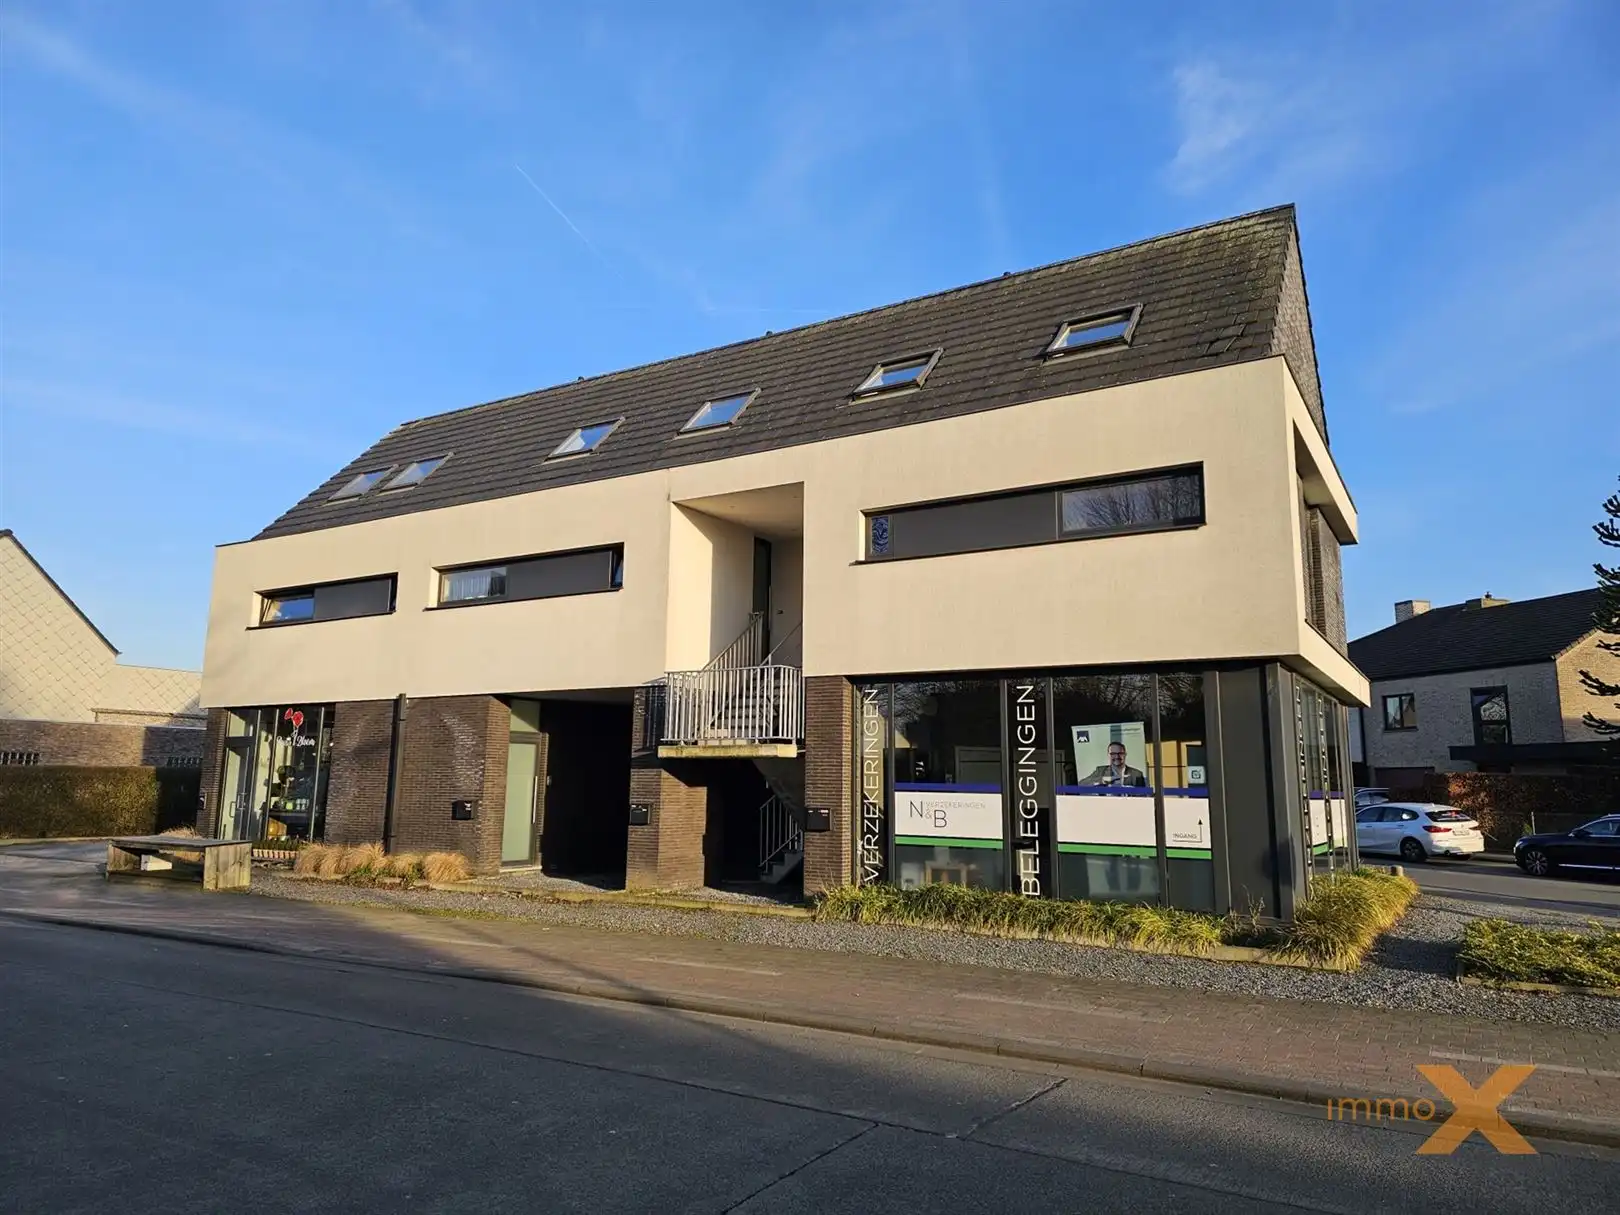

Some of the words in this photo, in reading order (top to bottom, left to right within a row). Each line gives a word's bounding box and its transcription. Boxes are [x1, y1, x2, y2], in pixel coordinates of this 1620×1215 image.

[864, 689, 880, 882] VERZEKERINGEN
[909, 800, 923, 818] N
[933, 809, 948, 828] B
[1016, 685, 1041, 896] BELEGGINGEN
